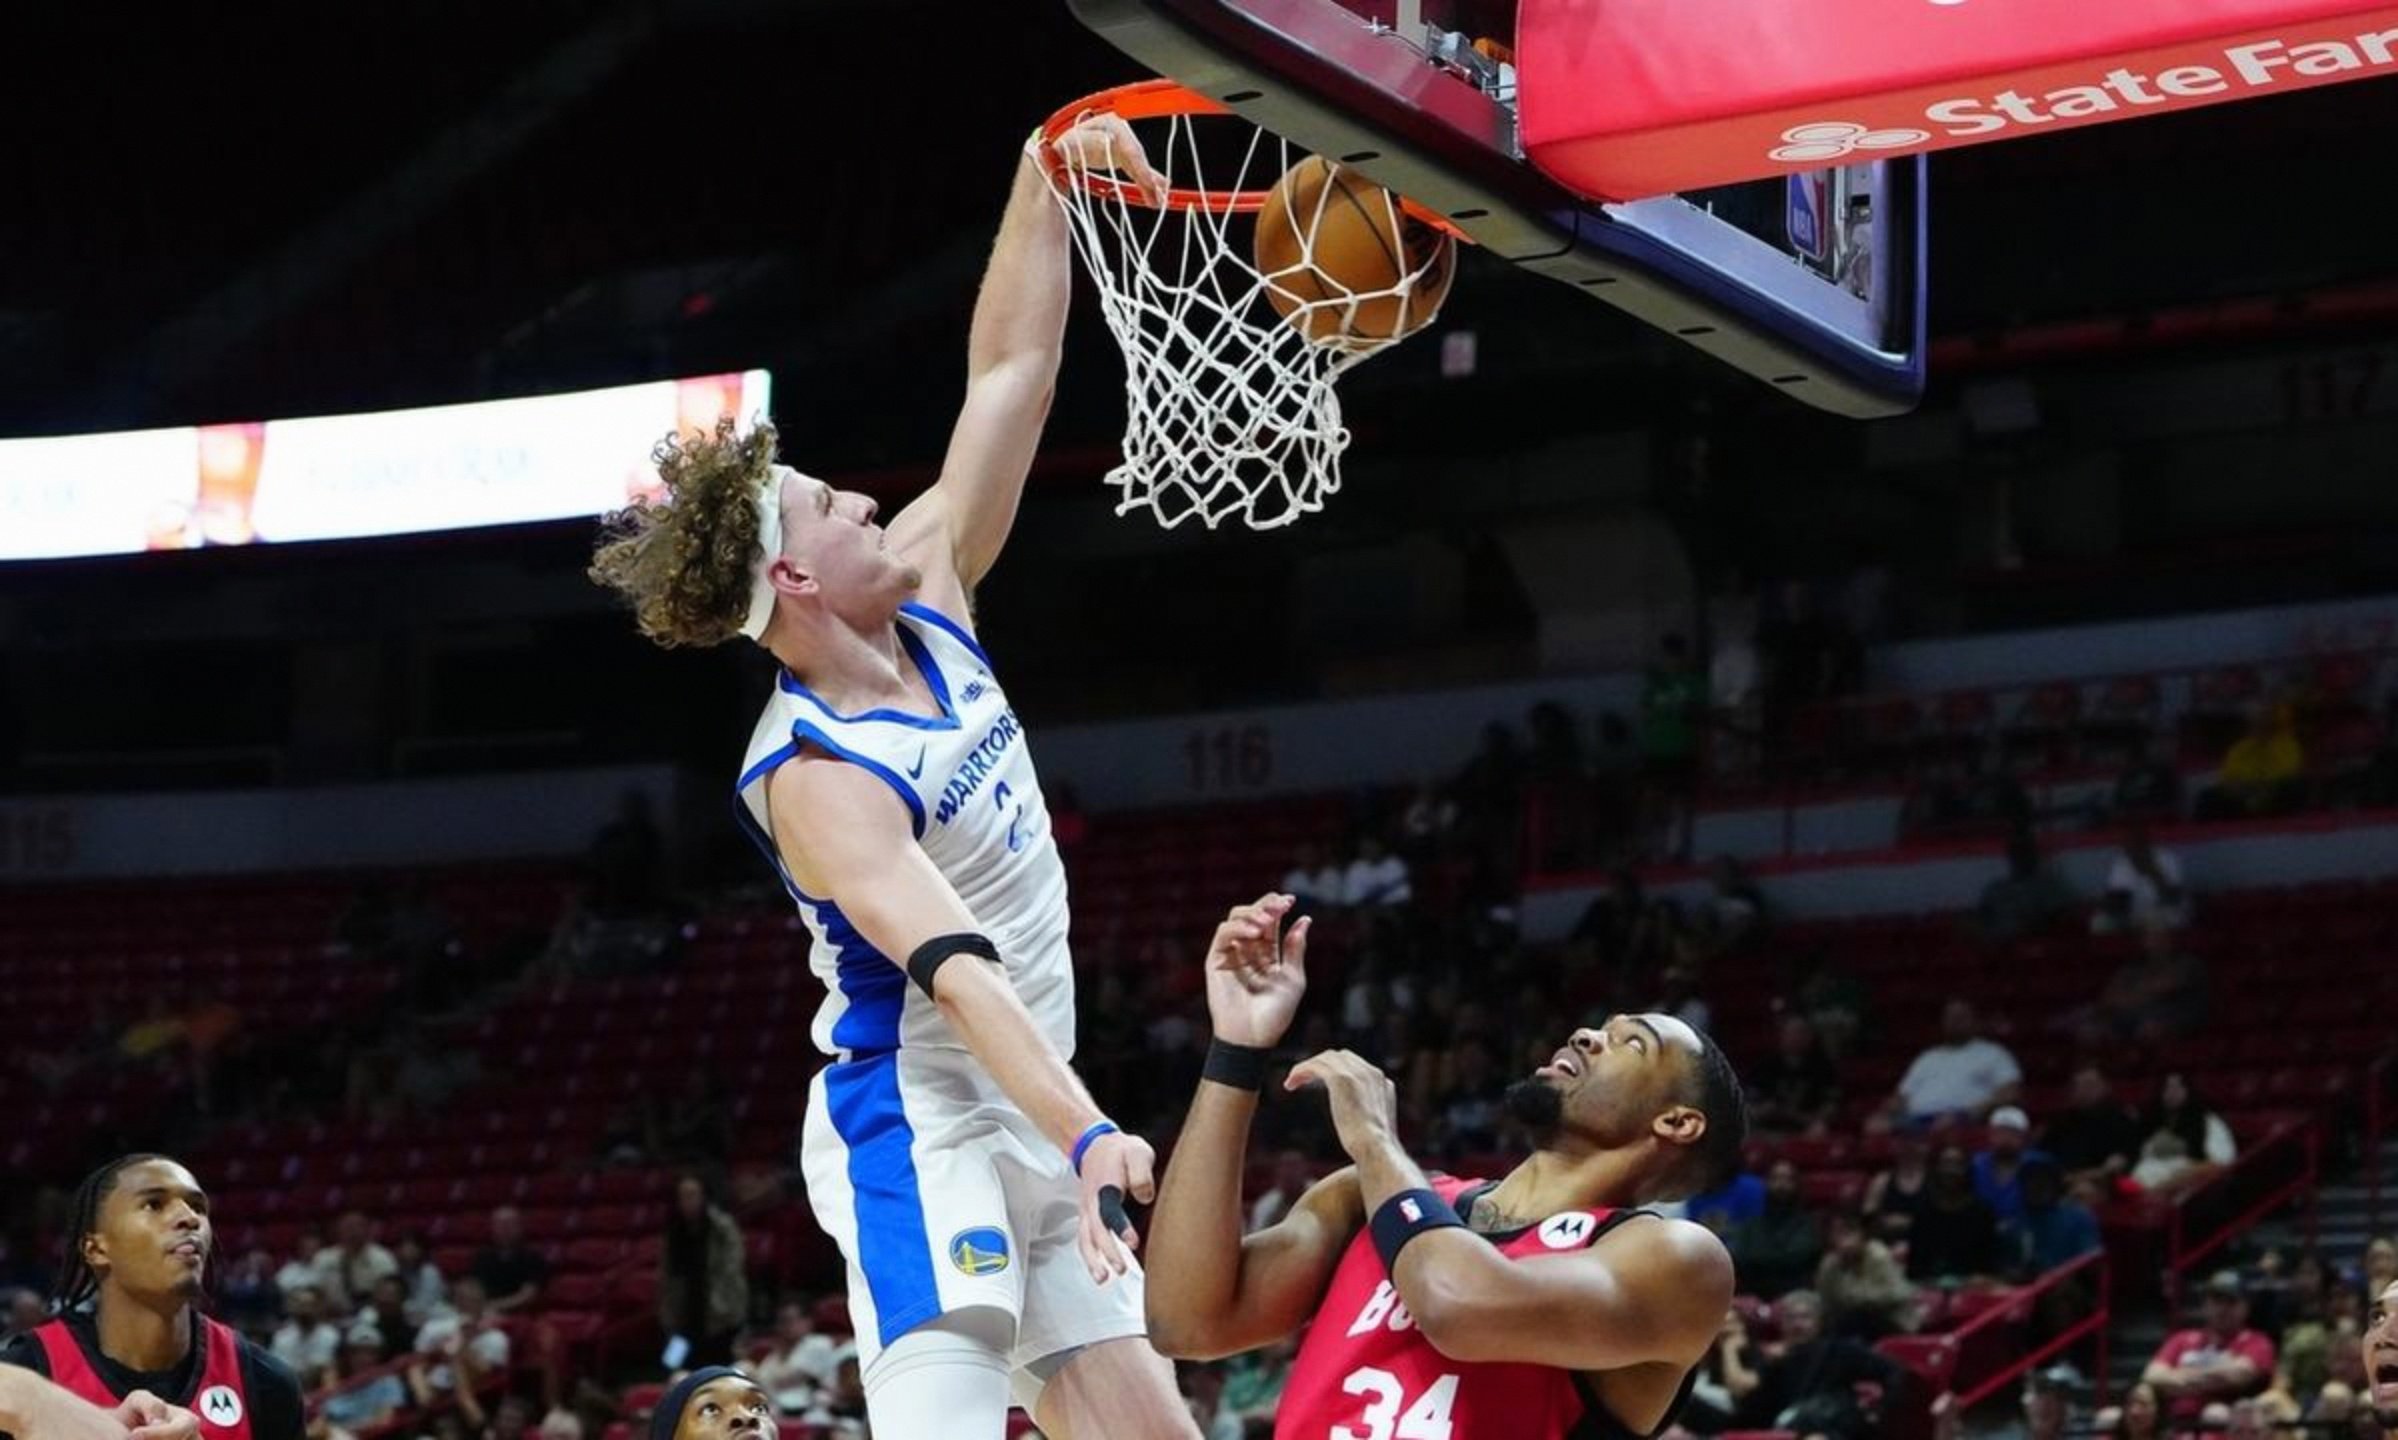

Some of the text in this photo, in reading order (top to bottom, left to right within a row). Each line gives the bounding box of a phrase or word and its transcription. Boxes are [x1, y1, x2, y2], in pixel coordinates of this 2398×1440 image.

[1925, 28, 2398, 136] State Far
[935, 706, 1023, 826] WARRIORS
[1184, 723, 1272, 791] 116
[1330, 1366, 1460, 1440] 34
